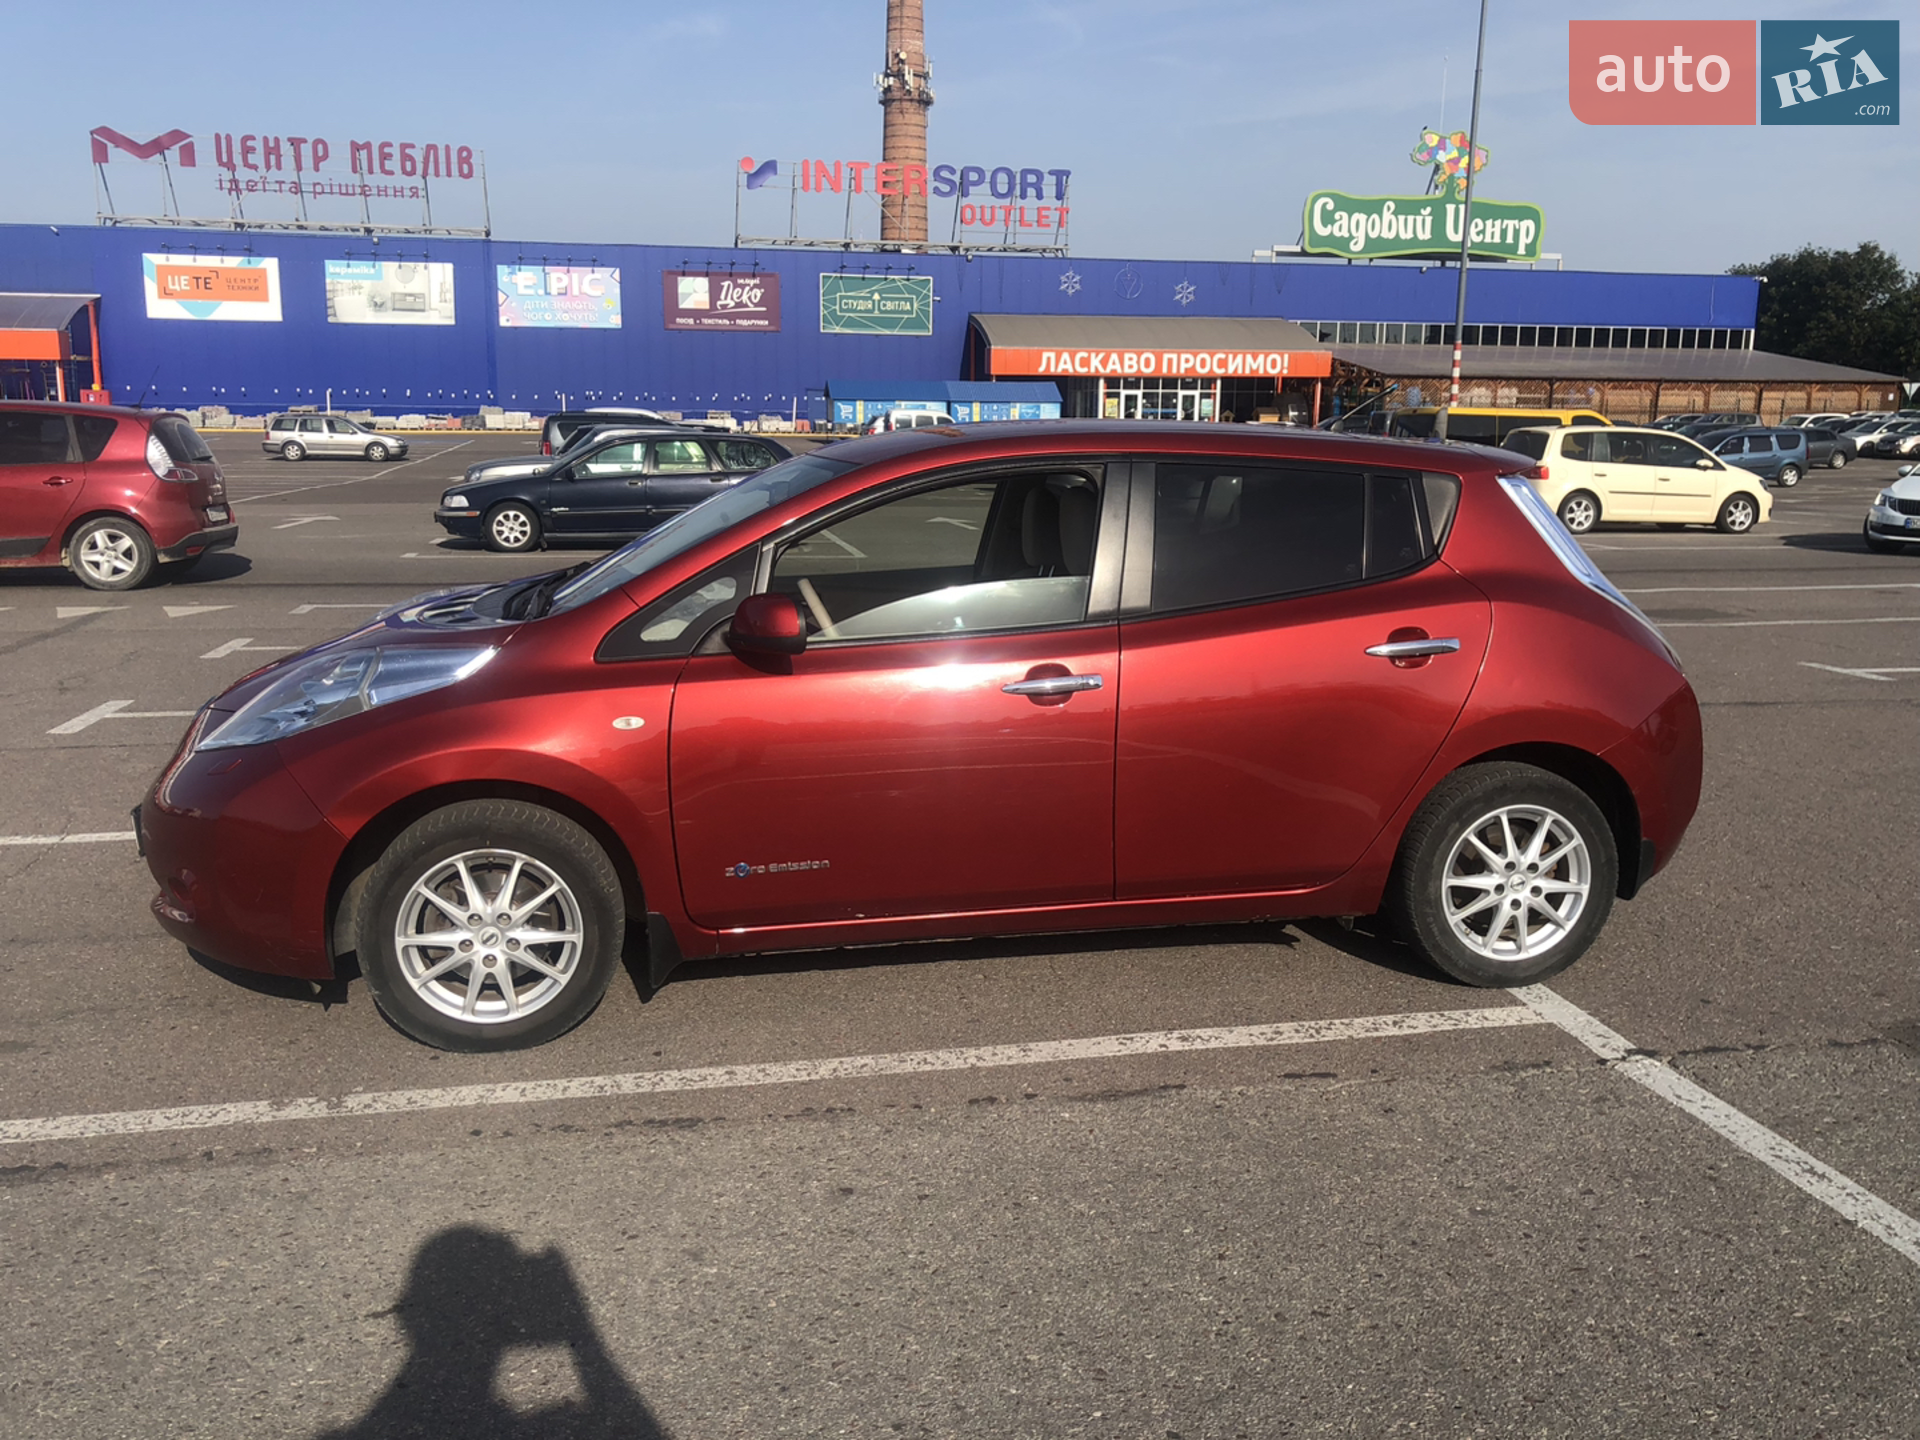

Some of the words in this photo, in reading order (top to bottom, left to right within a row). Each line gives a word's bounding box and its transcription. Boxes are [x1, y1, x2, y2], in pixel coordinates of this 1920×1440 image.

[214, 132, 330, 173] ЦЕНТР
[349, 139, 475, 180] МЕБЛІВ
[217, 173, 270, 197] ідеї
[311, 180, 421, 200] рішення
[801, 158, 1072, 202] INTERSPORT
[960, 203, 1071, 229] OUTLET
[1312, 196, 1434, 252] Садовий
[841, 299, 873, 311] СТУДІЯ
[880, 300, 912, 312] СВІТЛА
[1037, 351, 1156, 374] ЛАСКАВО
[1161, 352, 1290, 375] ПРОСИМО!
